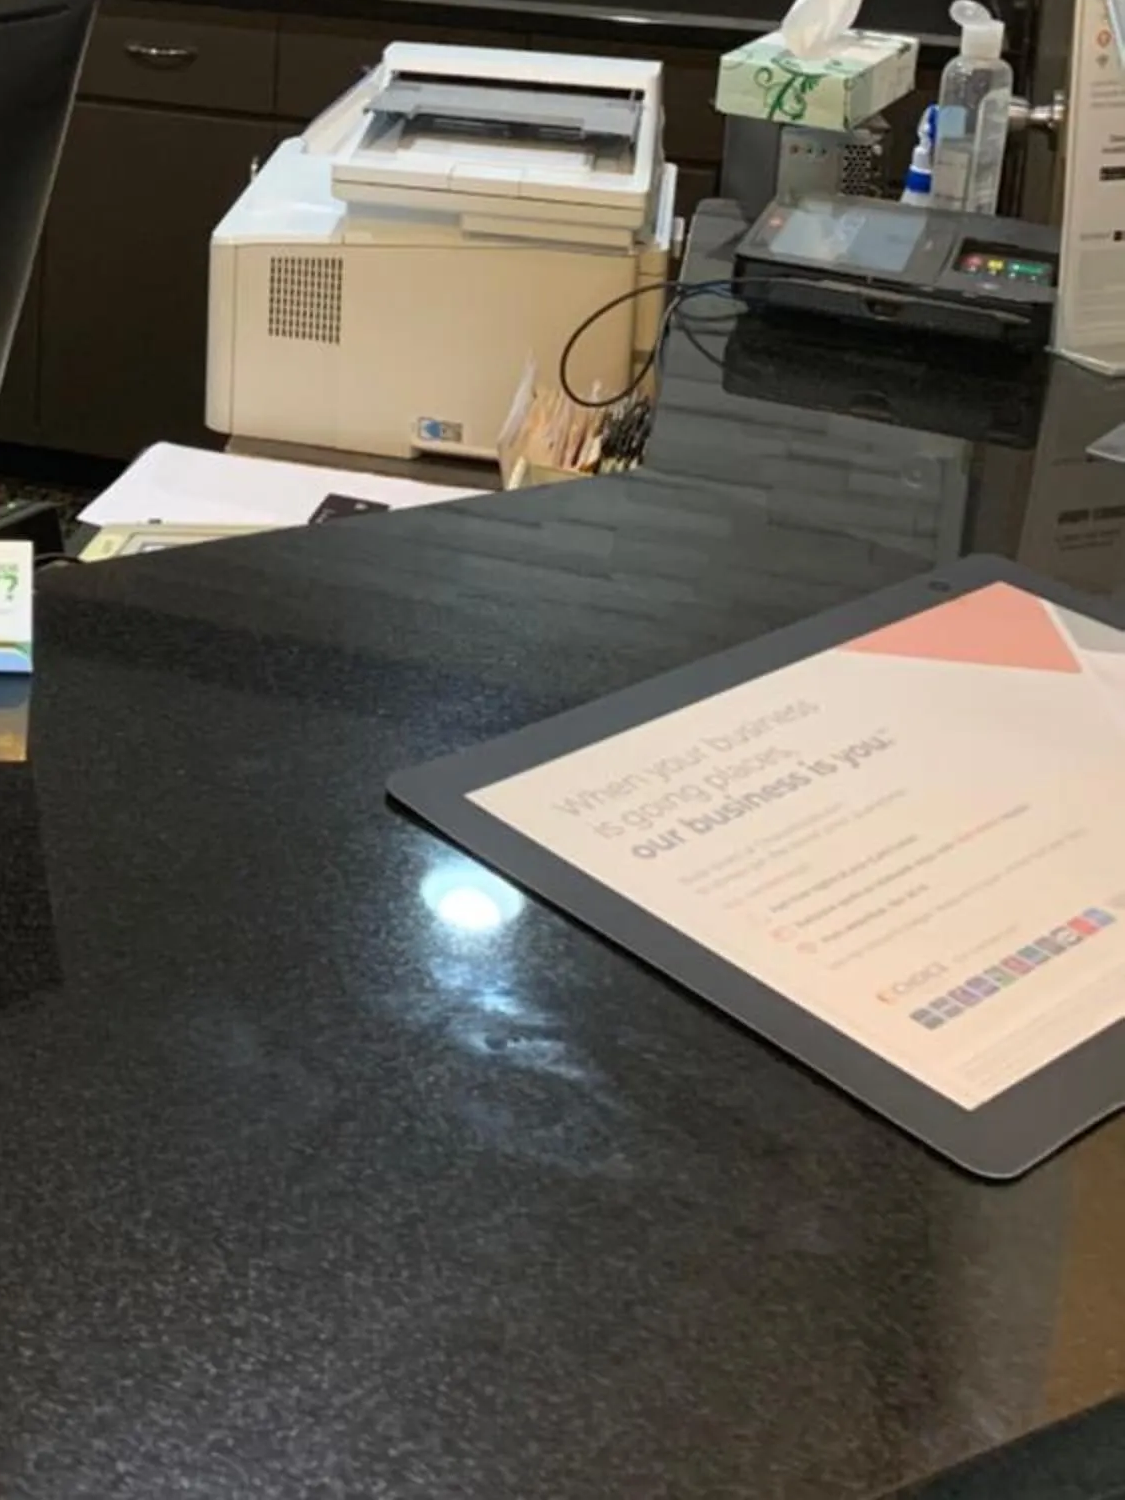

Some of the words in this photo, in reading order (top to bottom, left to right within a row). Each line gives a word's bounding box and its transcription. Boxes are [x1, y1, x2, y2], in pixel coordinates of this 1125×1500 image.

[630, 828, 687, 860] our
[676, 770, 813, 835] business
[795, 758, 839, 777] is
